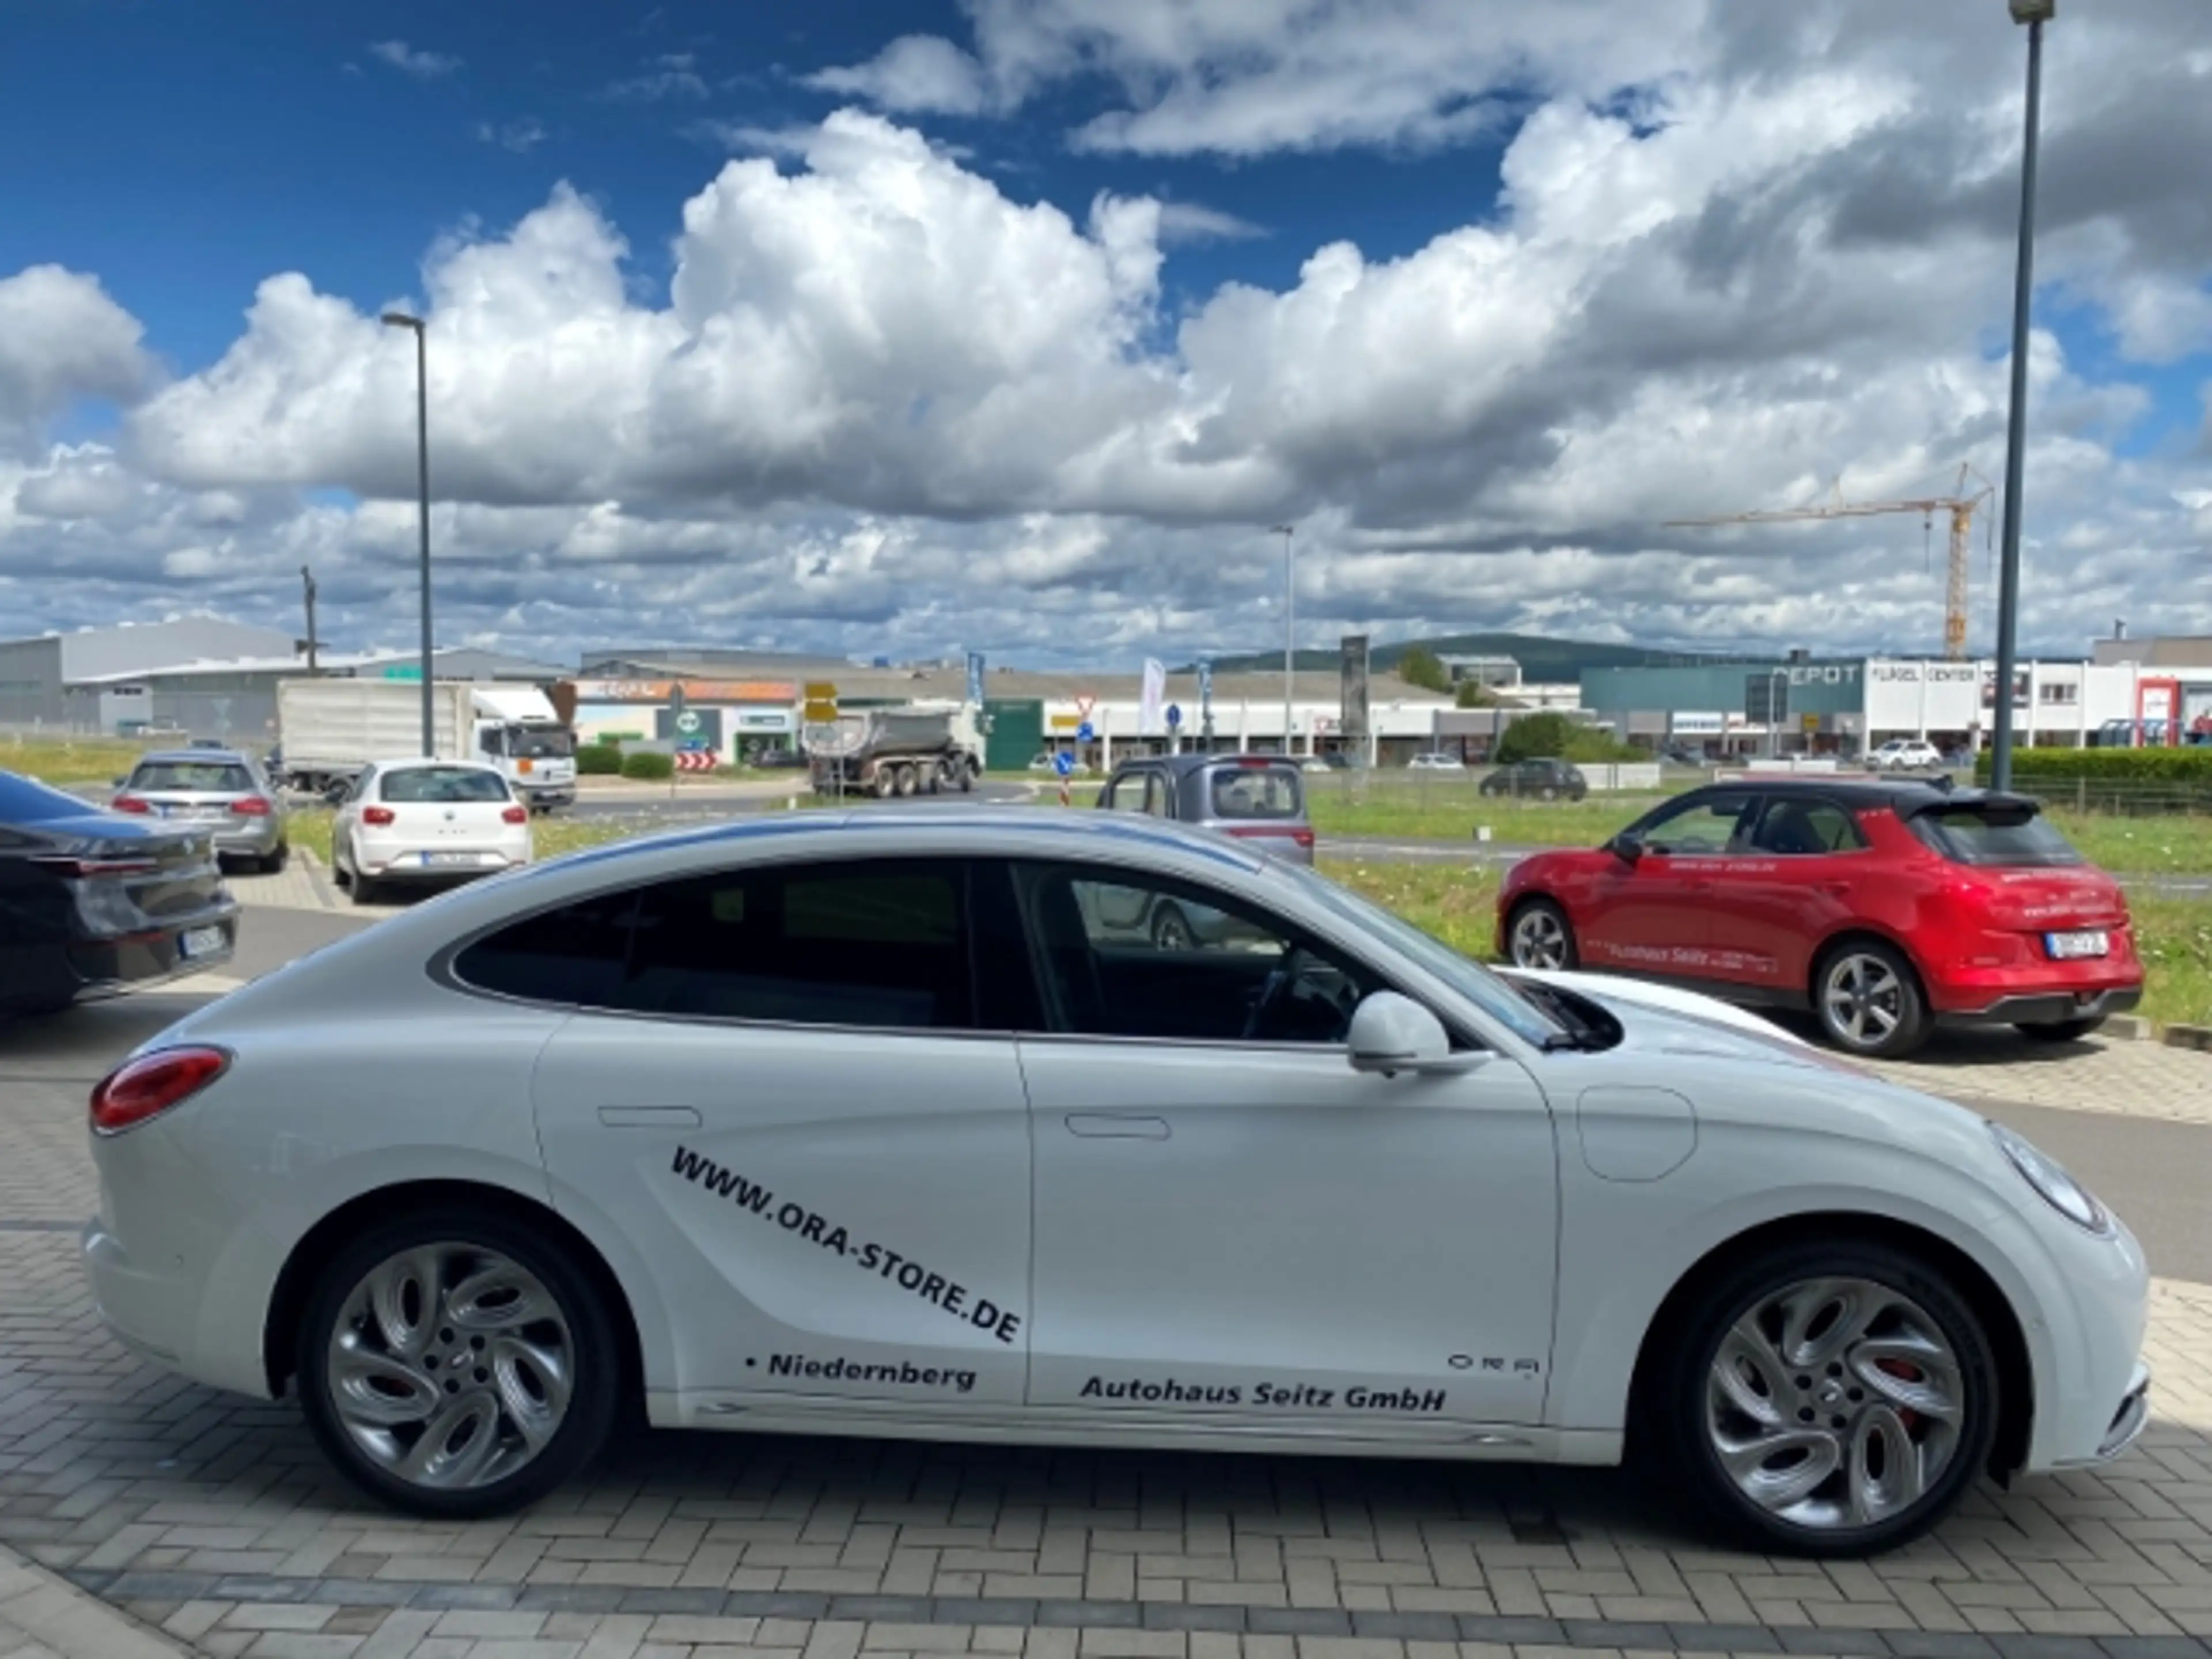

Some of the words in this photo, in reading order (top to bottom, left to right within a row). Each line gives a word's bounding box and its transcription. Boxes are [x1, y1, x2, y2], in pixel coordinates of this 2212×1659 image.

[670, 1145, 1021, 1343] WWW.ORA-STORE.DE
[768, 1354, 976, 1392] Niedernberg
[1080, 1376, 1241, 1404] Autohaus
[1252, 1382, 1335, 1407] Seitz
[1344, 1385, 1446, 1411] GmbH
